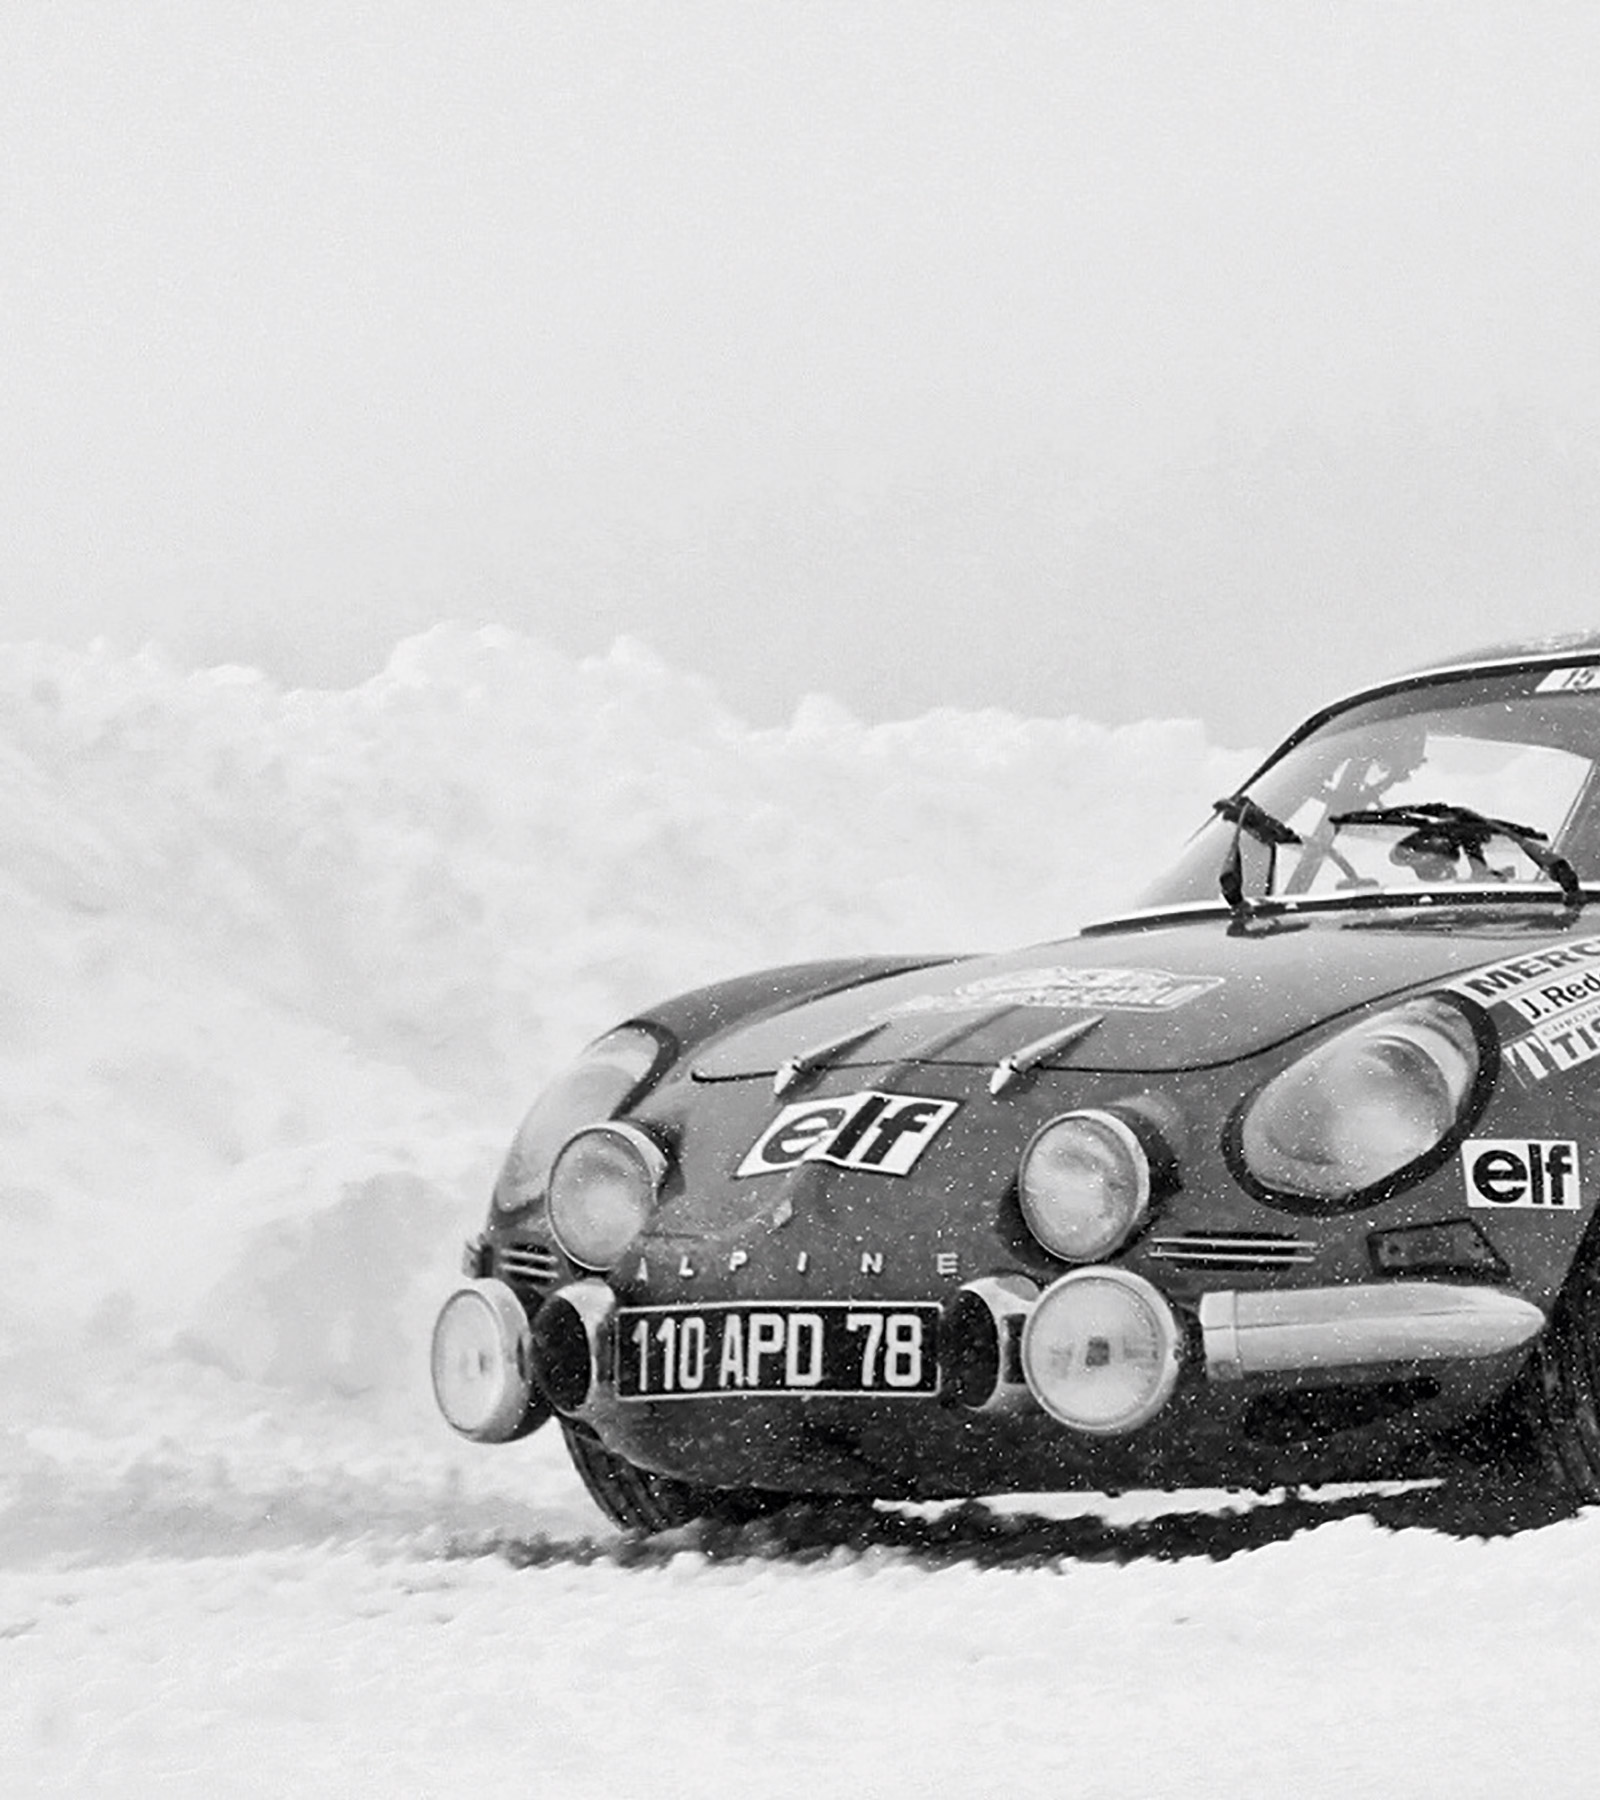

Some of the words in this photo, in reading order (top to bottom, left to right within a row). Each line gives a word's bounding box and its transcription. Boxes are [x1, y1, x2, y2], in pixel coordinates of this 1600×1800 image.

[760, 1095, 945, 1167] elf
[1472, 1143, 1573, 1206] elf
[634, 1250, 961, 1283] ALPINE
[630, 1318, 705, 1392] 110
[718, 1315, 825, 1390] APD
[845, 1313, 923, 1387] 78
